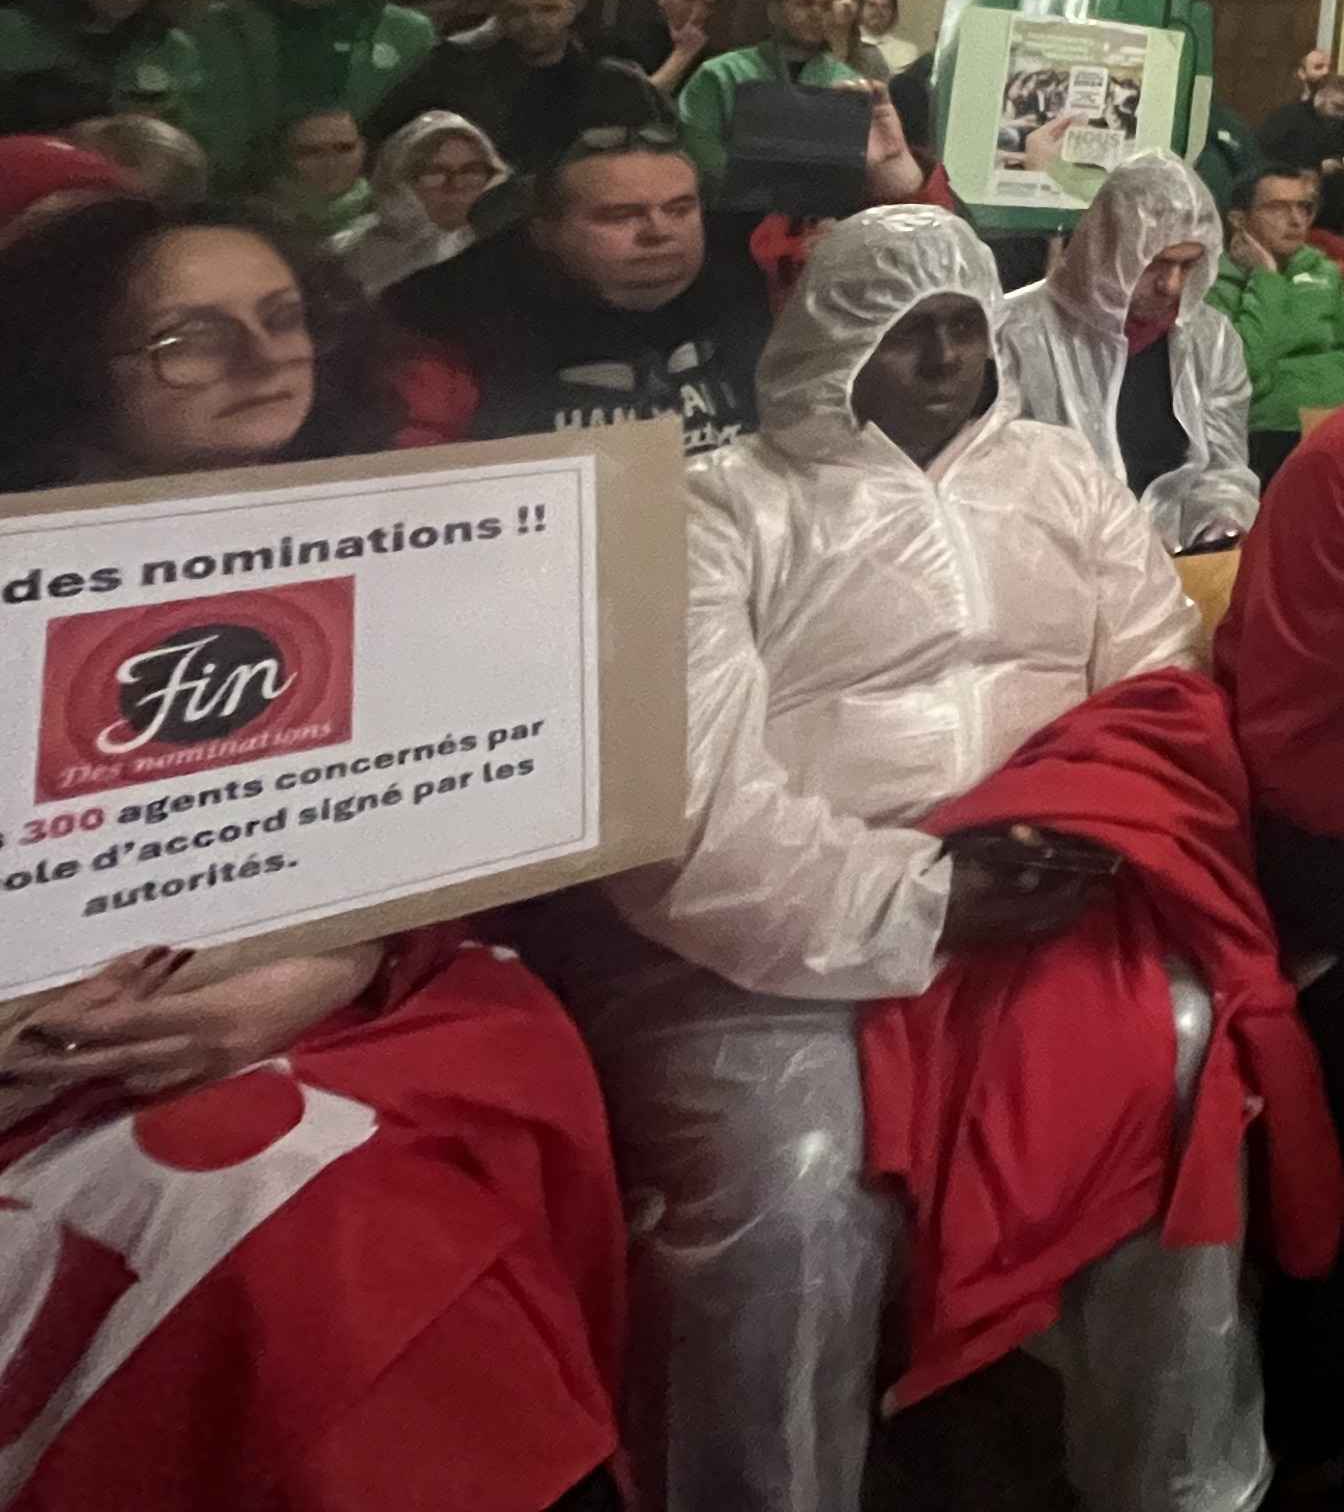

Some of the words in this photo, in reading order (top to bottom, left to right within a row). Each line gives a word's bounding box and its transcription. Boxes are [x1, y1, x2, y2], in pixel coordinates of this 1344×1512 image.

[1, 567, 123, 604] des
[140, 517, 502, 586] nominations
[517, 504, 546, 534] !!
[95, 634, 298, 750] Fin
[18, 806, 105, 845] 300
[116, 777, 264, 825] agents
[274, 732, 478, 790] concernés
[486, 718, 545, 752] par
[133, 721, 332, 772] nominations
[0, 857, 81, 890] ole
[297, 782, 403, 826] signé
[411, 771, 474, 806] par
[481, 758, 535, 784] les
[80, 852, 298, 917] autorités.
